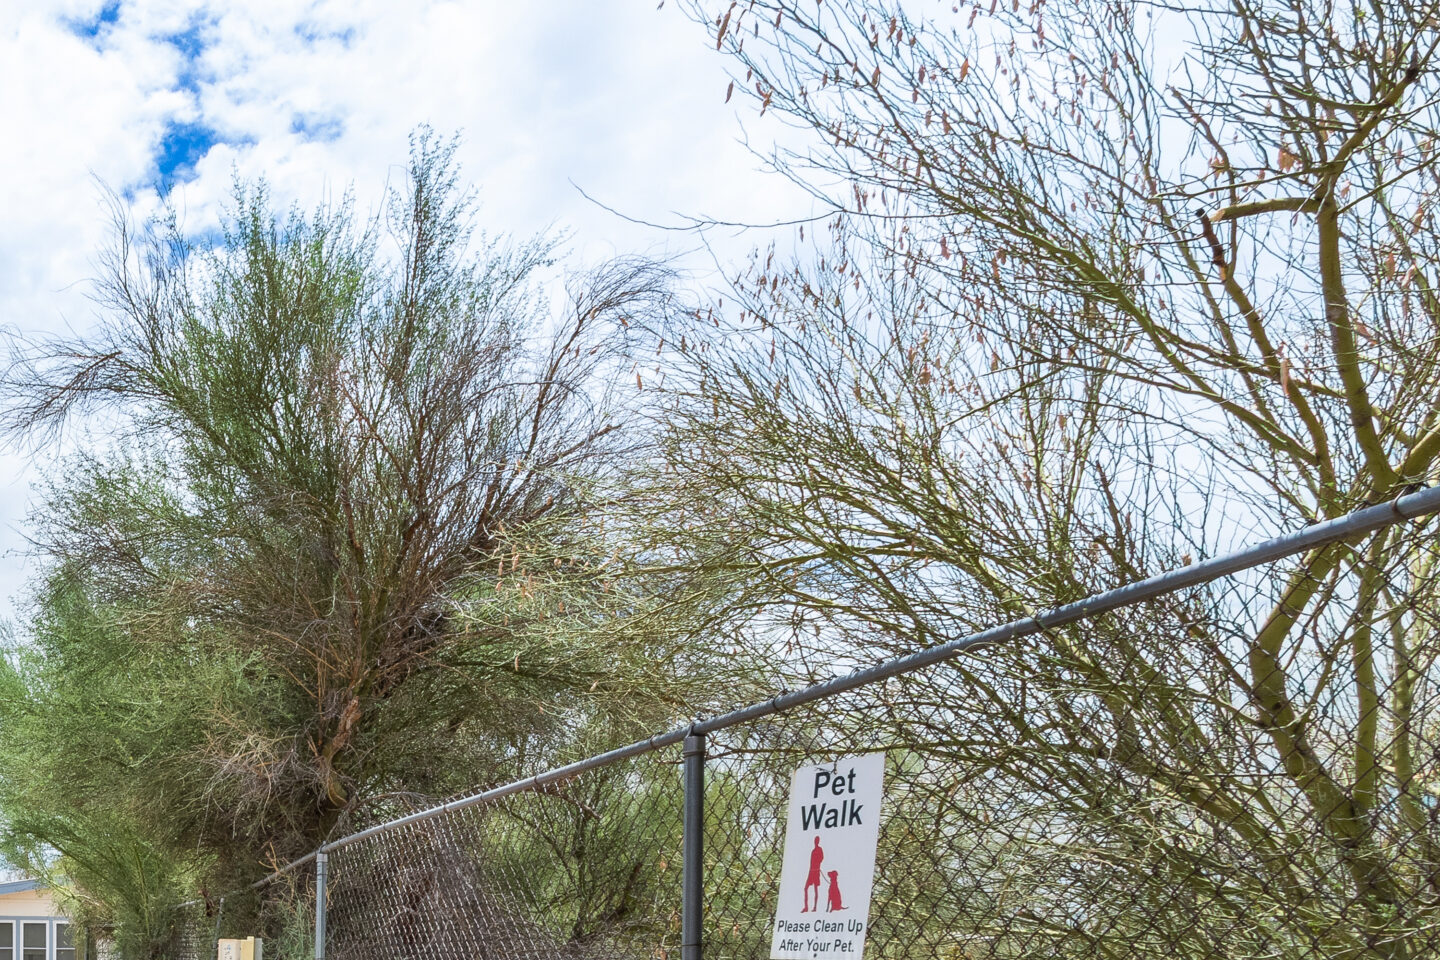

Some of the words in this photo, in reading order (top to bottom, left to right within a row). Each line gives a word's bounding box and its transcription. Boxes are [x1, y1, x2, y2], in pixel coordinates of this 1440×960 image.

[813, 767, 856, 799] Pet
[801, 799, 864, 831] Walk
[777, 919, 811, 933] Please
[813, 919, 844, 933] Clean
[847, 919, 863, 936] Up
[778, 938, 804, 952] After
[806, 938, 831, 952] Your
[833, 938, 855, 953] Pet.
